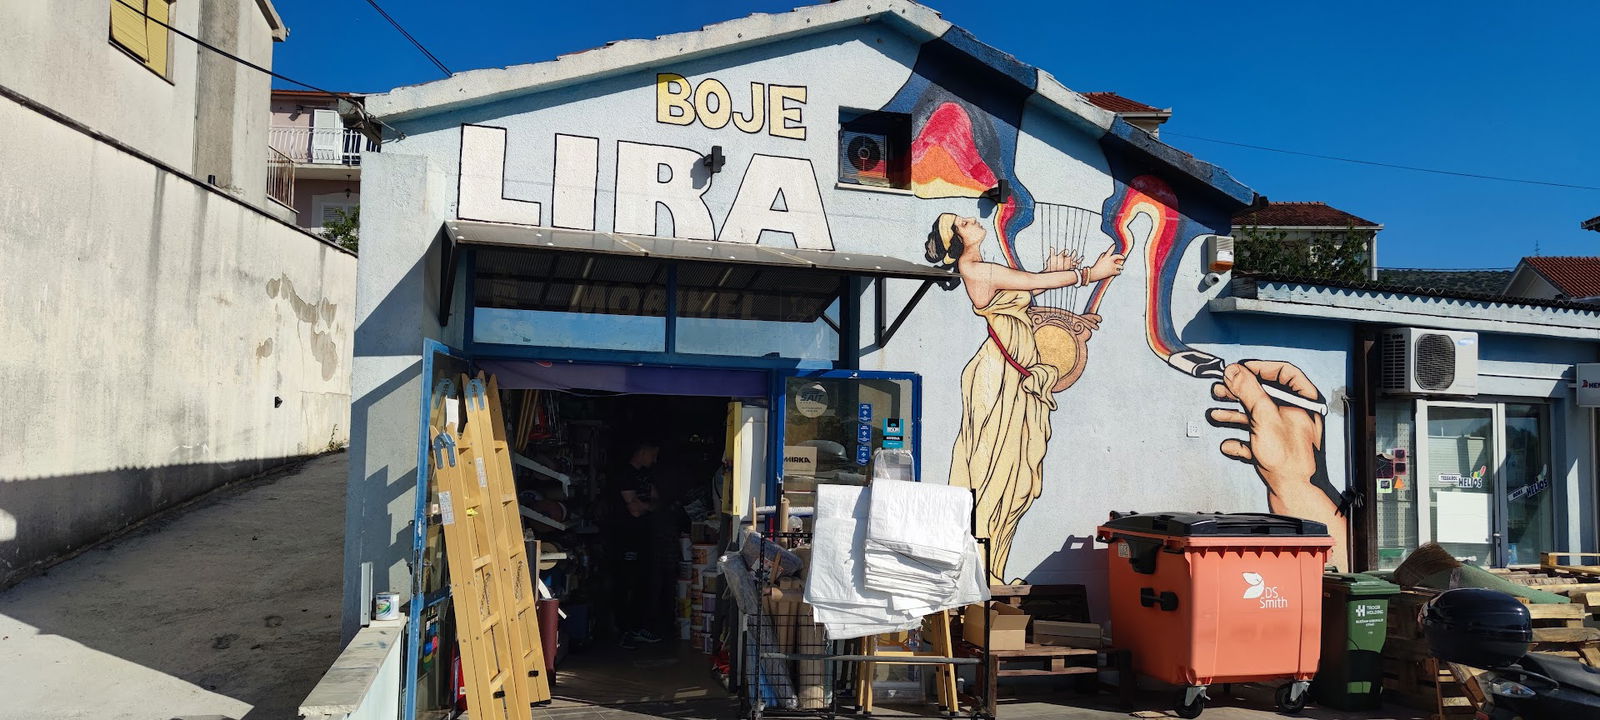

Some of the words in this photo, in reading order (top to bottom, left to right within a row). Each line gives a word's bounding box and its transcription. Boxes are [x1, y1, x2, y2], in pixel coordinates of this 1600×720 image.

[656, 73, 808, 141] BOJE
[457, 123, 835, 252] LIRA
[784, 456, 811, 464] MIRKA
[1458, 477, 1482, 488] HELIOS
[1526, 479, 1548, 496] HELIOS
[1265, 586, 1279, 599] DS
[1259, 596, 1288, 609] Smith
